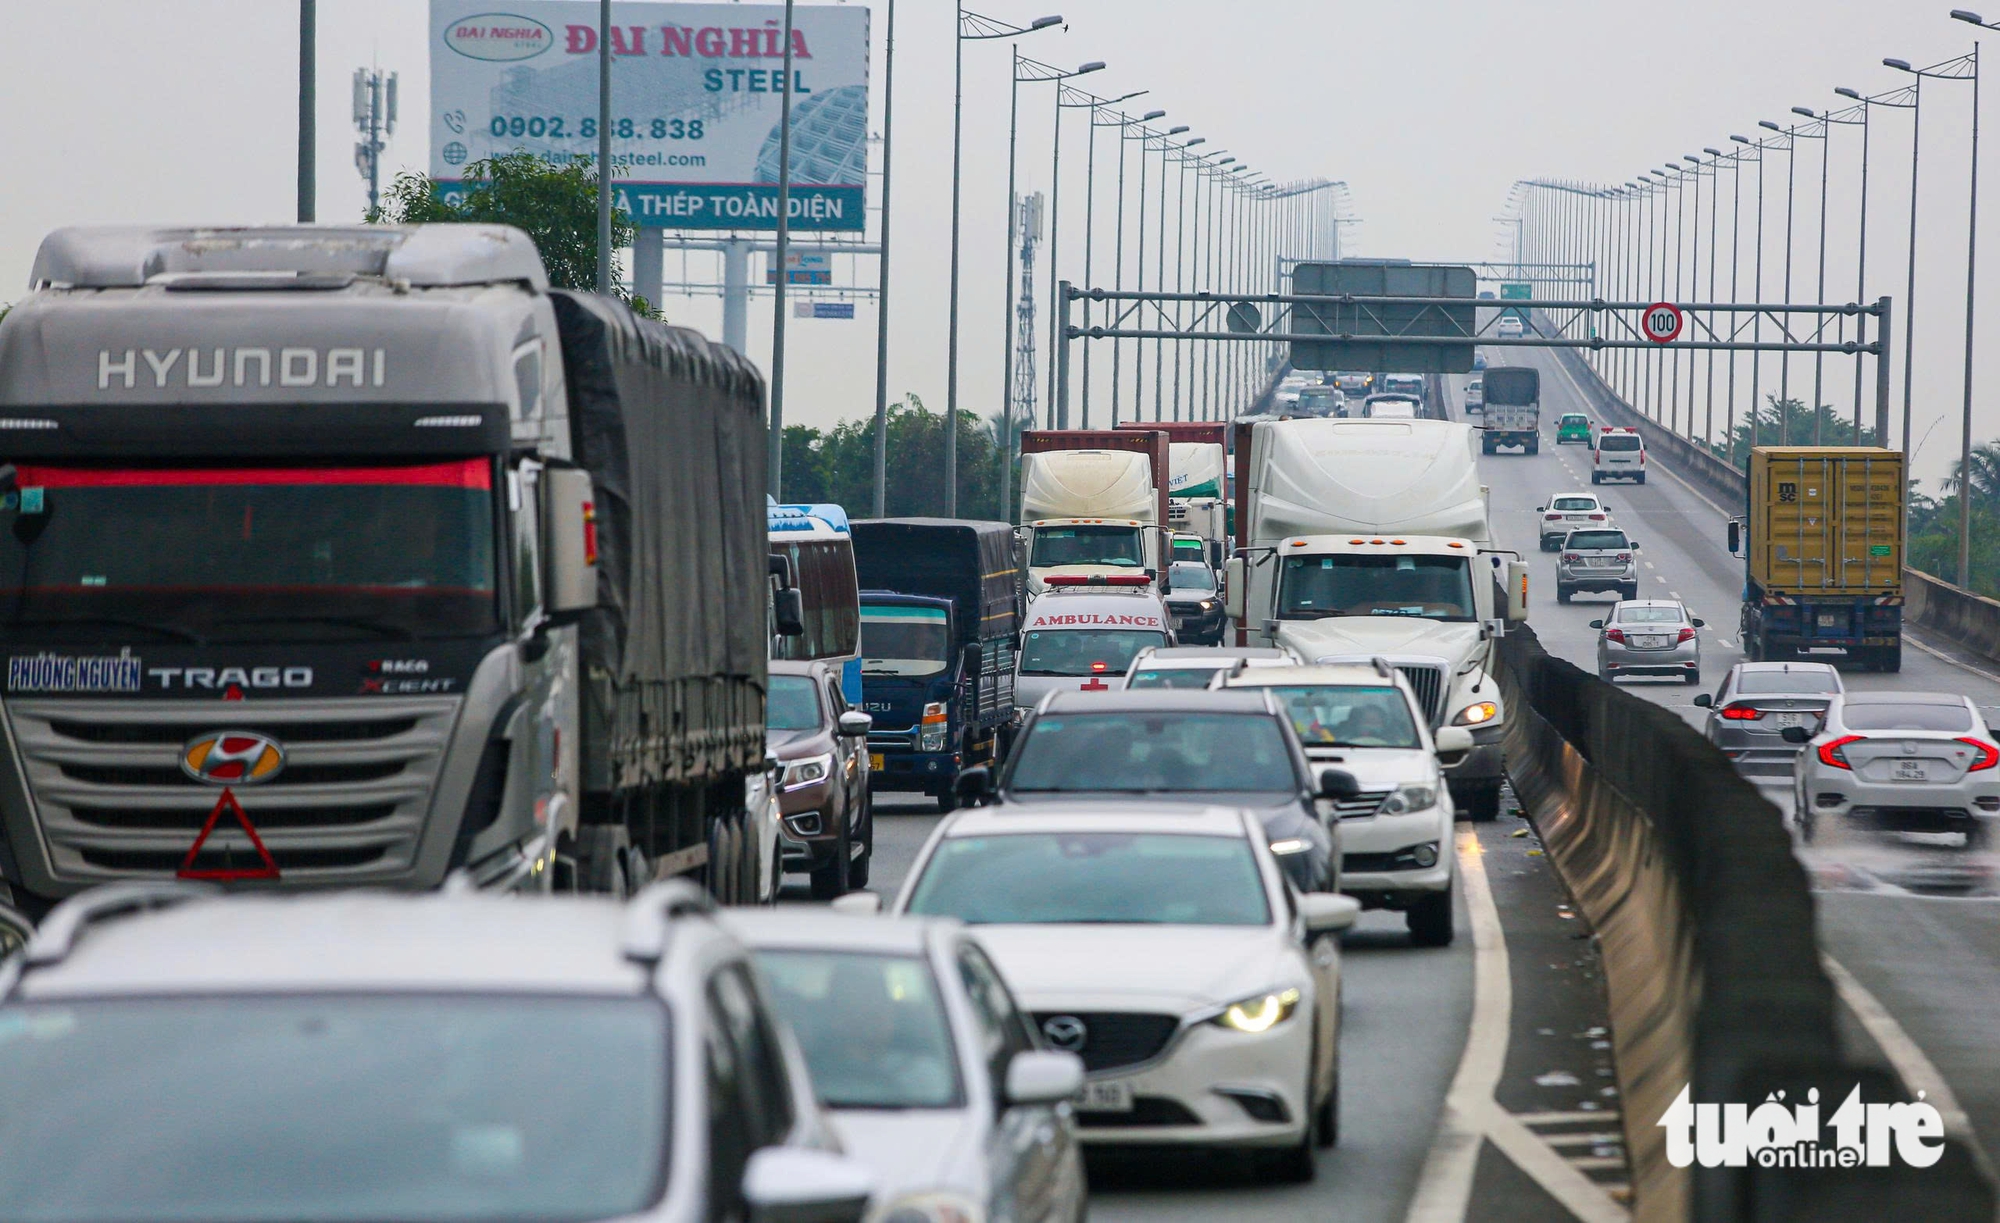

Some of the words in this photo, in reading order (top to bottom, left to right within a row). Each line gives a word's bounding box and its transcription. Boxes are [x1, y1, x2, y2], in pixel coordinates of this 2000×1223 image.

[660, 19, 813, 59] NGHĨA
[703, 68, 811, 93] STEEL
[490, 116, 572, 138] 0902.
[580, 117, 643, 139] 88.
[651, 118, 704, 140] 838
[638, 190, 705, 216] THÉP
[710, 192, 778, 218] TOÀN
[787, 193, 842, 222] DIỆN
[1651, 313, 1675, 332] 100
[98, 346, 387, 390] HYUNDAI
[1033, 614, 1159, 627] AMBULANCE
[148, 666, 313, 688] TRAGO
